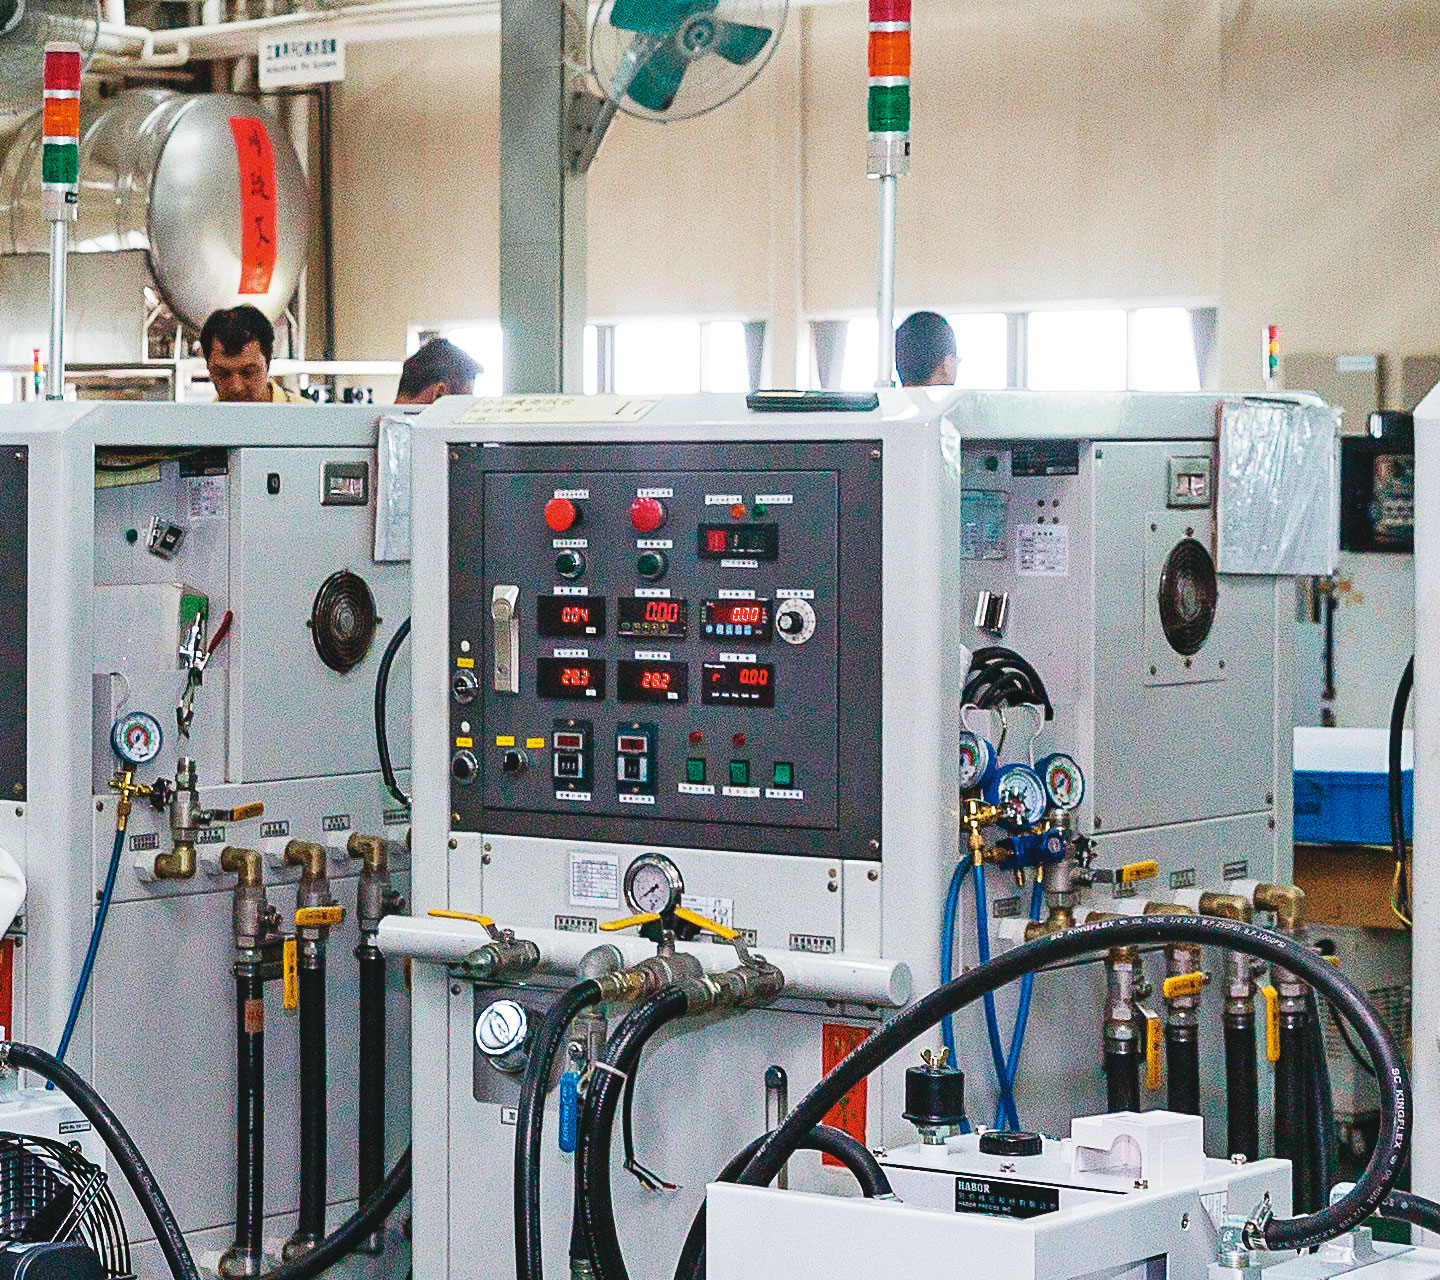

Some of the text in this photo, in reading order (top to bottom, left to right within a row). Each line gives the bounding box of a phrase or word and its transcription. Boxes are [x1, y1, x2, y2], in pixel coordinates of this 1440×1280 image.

[1391, 1067, 1402, 1084] SC
[1393, 1089, 1406, 1150] KINGFLEX
[958, 1181, 991, 1194] HABOR
